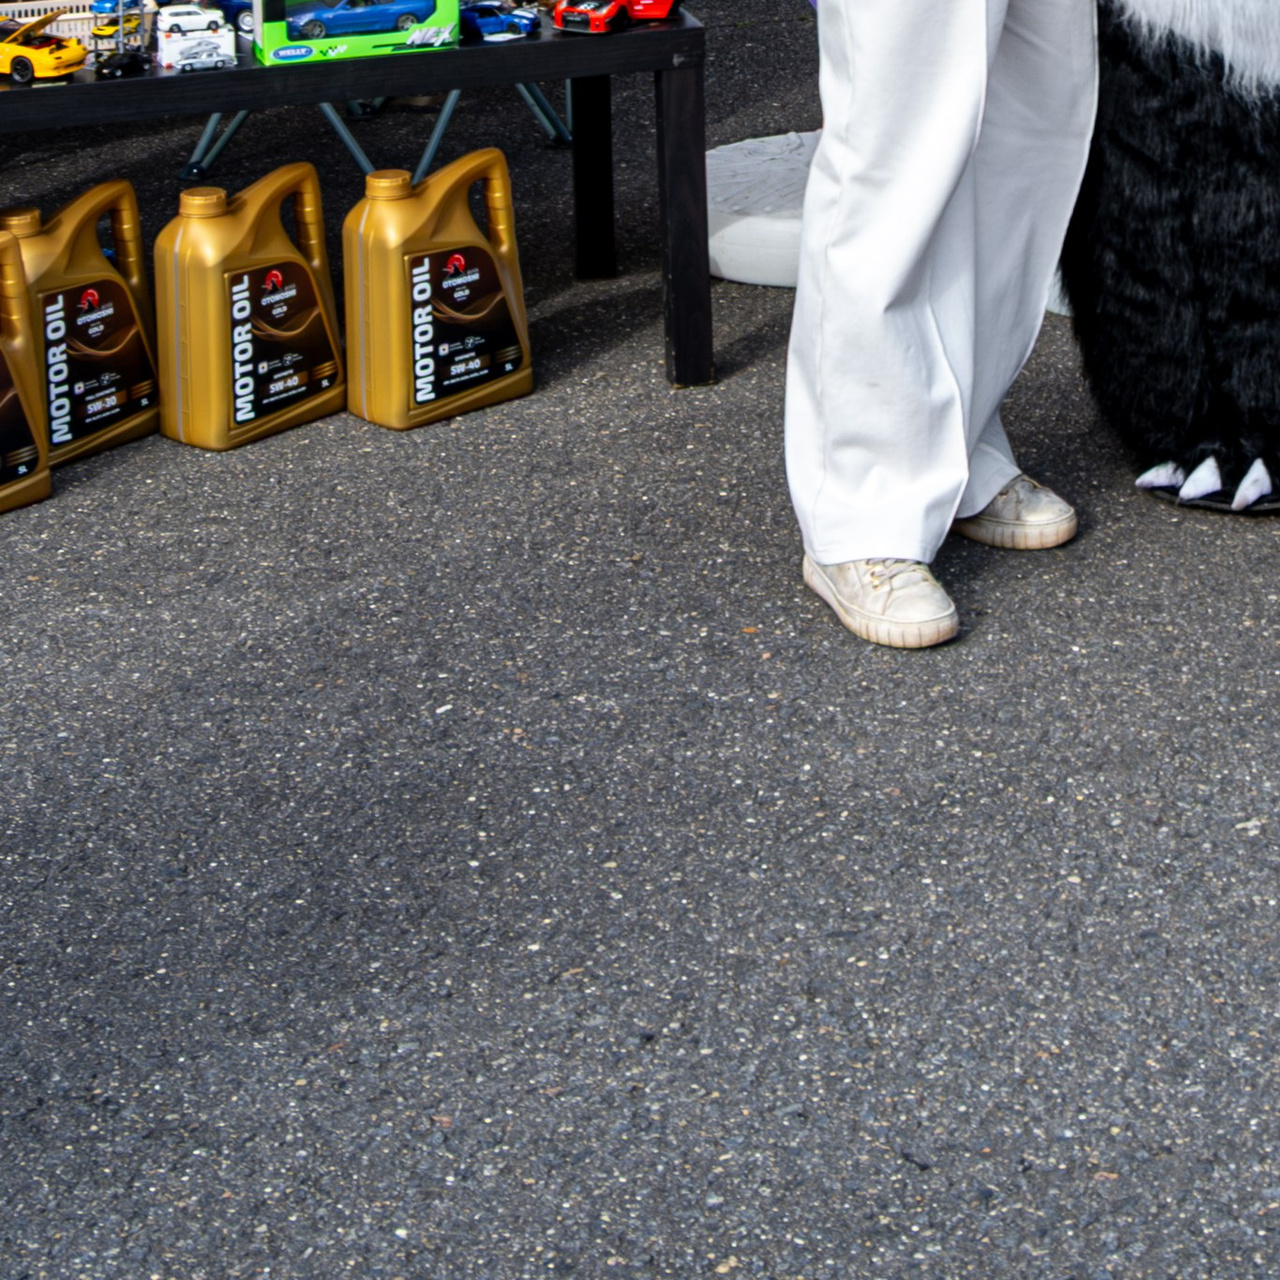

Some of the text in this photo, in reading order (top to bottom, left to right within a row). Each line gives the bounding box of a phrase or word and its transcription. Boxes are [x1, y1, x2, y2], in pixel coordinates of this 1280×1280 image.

[45, 294, 73, 444] MOTOR OIL
[232, 275, 255, 422] MOTOR OIL
[412, 257, 436, 402] MOTOR OIL
